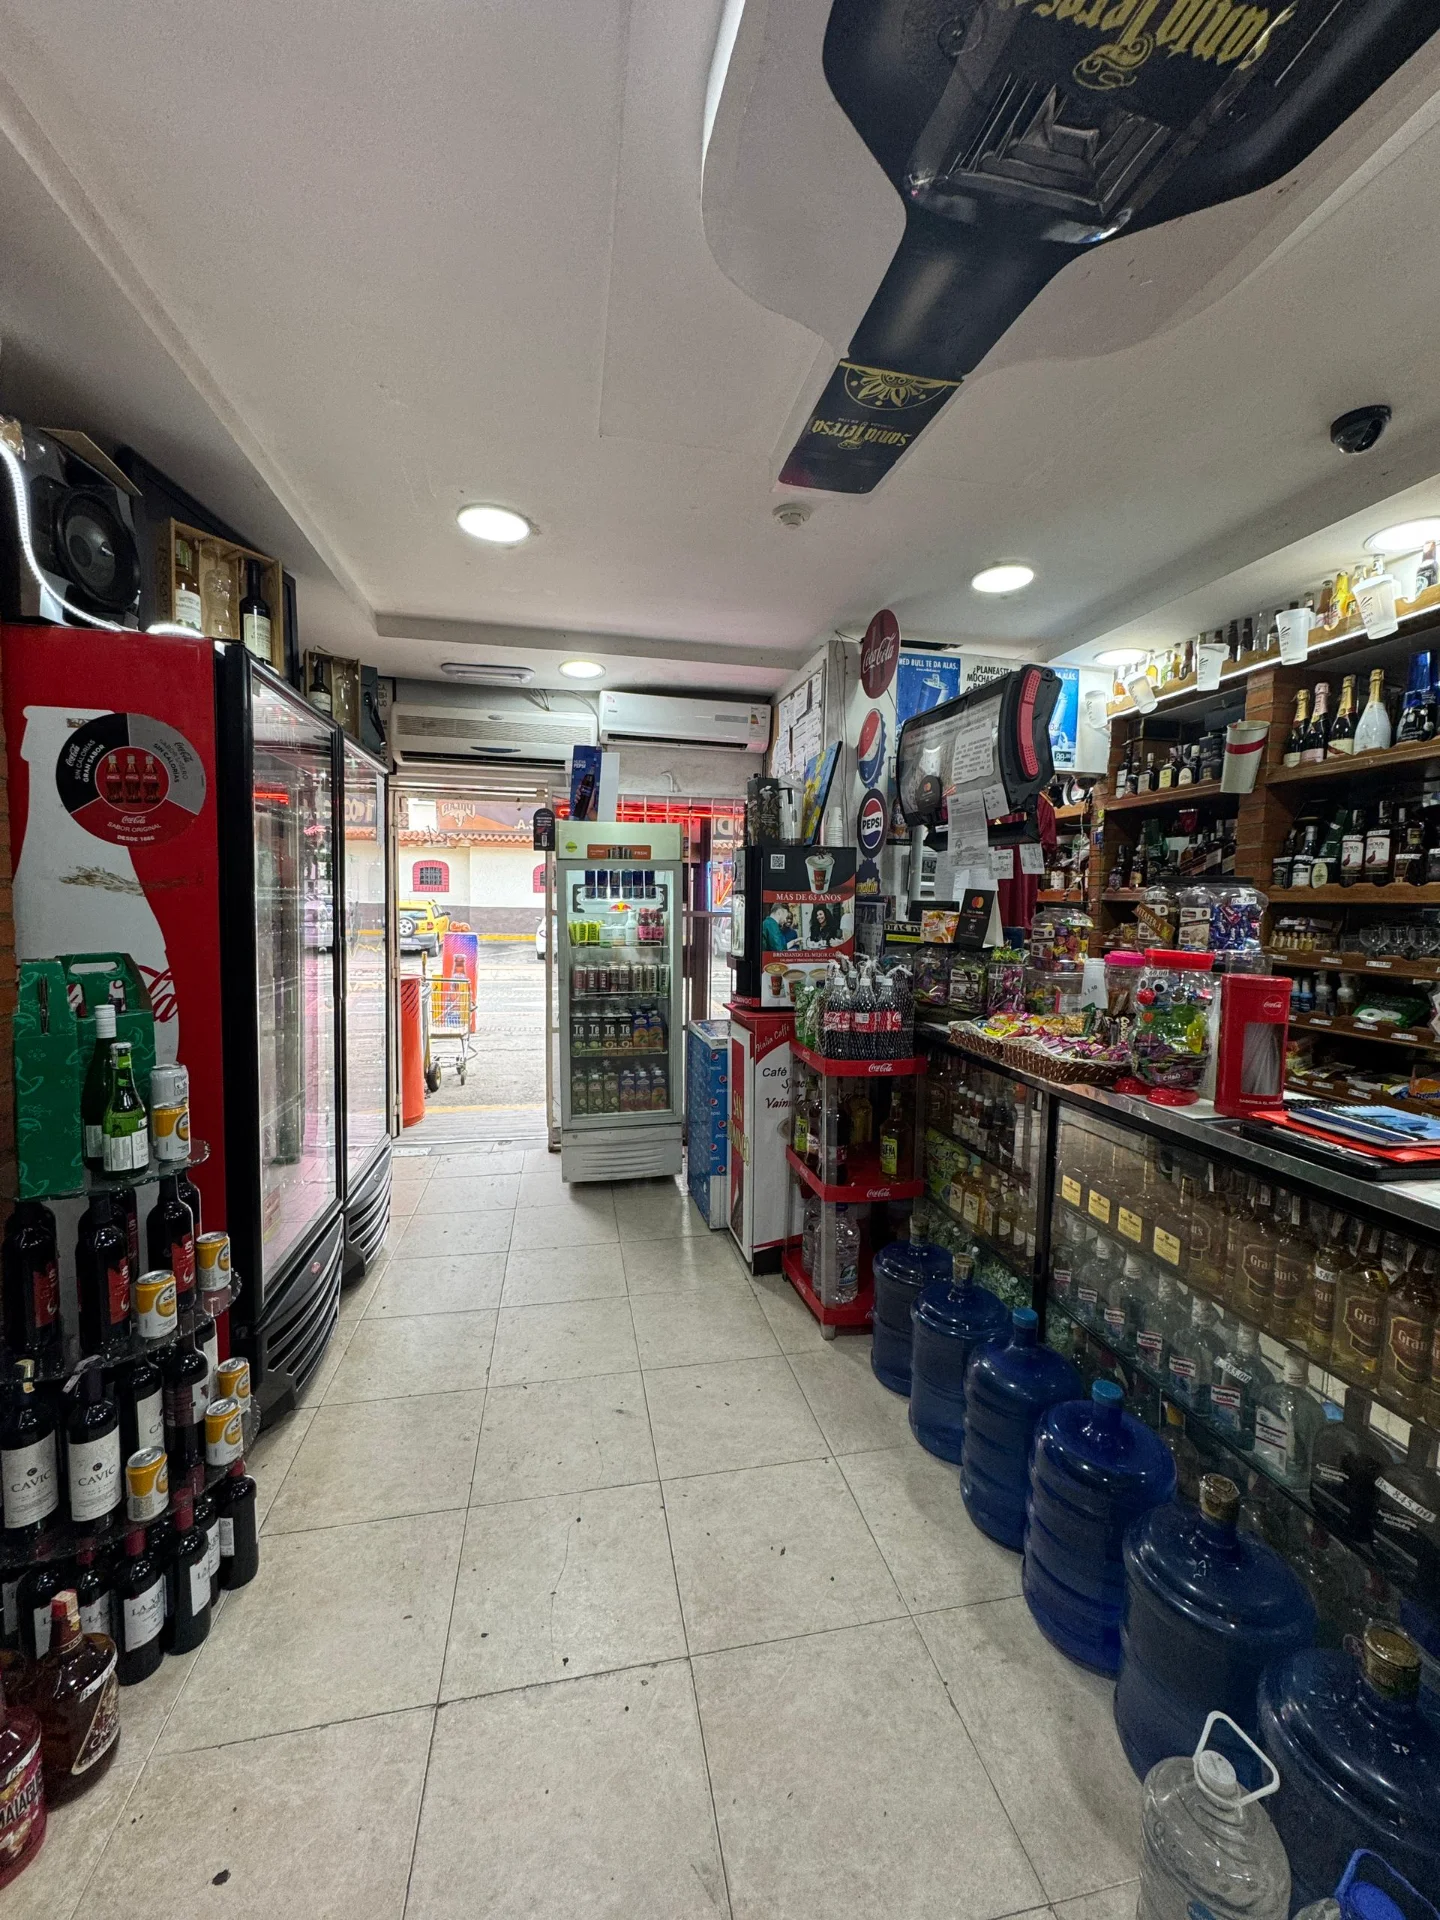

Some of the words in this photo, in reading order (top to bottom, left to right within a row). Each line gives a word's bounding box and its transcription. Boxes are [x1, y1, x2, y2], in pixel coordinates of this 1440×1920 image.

[862, 633, 896, 674] Coca-Cola
[911, 658, 925, 667] BULL
[933, 660, 942, 668] DA
[83, 763, 93, 783] GRAN
[88, 744, 105, 764] SABOR
[107, 822, 130, 832] SABOR
[131, 823, 162, 833] ORIGINAL
[862, 815, 882, 831] PEPSI
[117, 834, 138, 842] DESDE
[776, 892, 794, 901] MÁS
[819, 892, 842, 901] AÑOS
[762, 1067, 787, 1077] Café
[868, 1063, 894, 1073] Coca-Cola
[866, 1188, 891, 1198] Coca-Cola
[1251, 1255, 1270, 1269] Gra
[1274, 1269, 1299, 1282] ant's
[11, 1469, 51, 1492] CAVIC
[78, 1464, 116, 1487] CAVIC
[1392, 1489, 1432, 1521] 845.00
